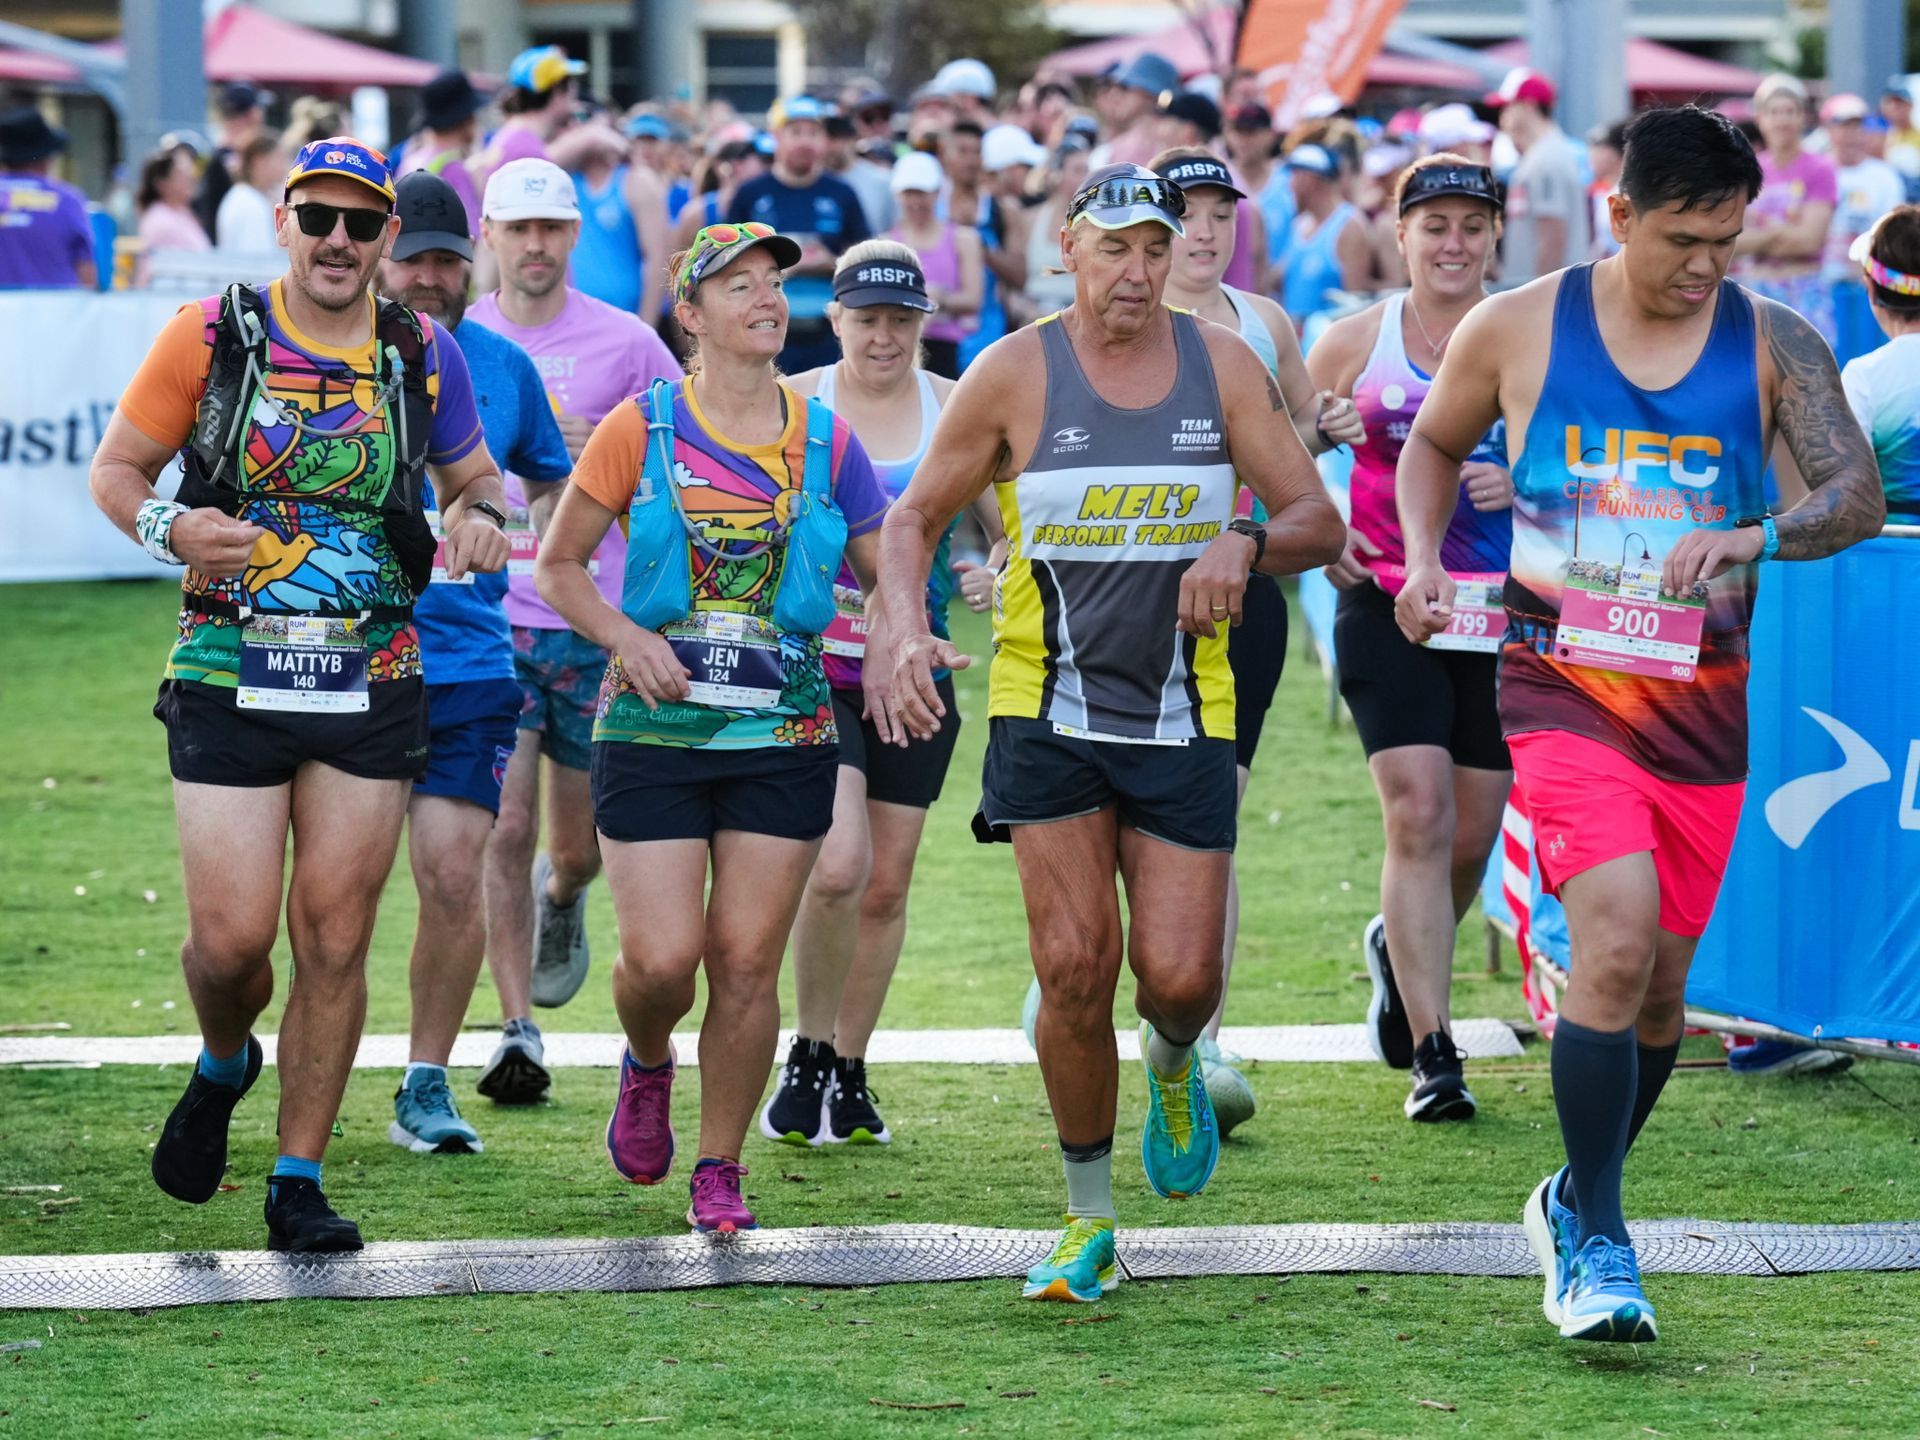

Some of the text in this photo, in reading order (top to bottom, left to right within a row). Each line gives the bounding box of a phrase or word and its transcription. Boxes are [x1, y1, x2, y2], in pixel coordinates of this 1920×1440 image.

[1168, 162, 1226, 179] #RSPT
[857, 267, 916, 286] #RSPT
[1181, 419, 1213, 431] TEAM
[1053, 443, 1090, 454] SCODY
[1171, 432, 1221, 445] TRIHARD
[1565, 424, 1722, 489] UFC
[1077, 483, 1200, 520] MEL'S
[1563, 481, 1624, 502] COFFS
[1596, 499, 1685, 521] RUNNING
[1033, 524, 1128, 546] PERSONAL
[1134, 520, 1222, 545] TRAINING
[1451, 612, 1488, 636] 799
[1608, 606, 1660, 638] 900
[267, 651, 342, 673] MATTYB
[702, 646, 740, 669] JEN
[293, 674, 316, 688] 140
[708, 668, 730, 683] 124
[1671, 665, 1691, 677] 900
[649, 705, 701, 724] Guzzler
